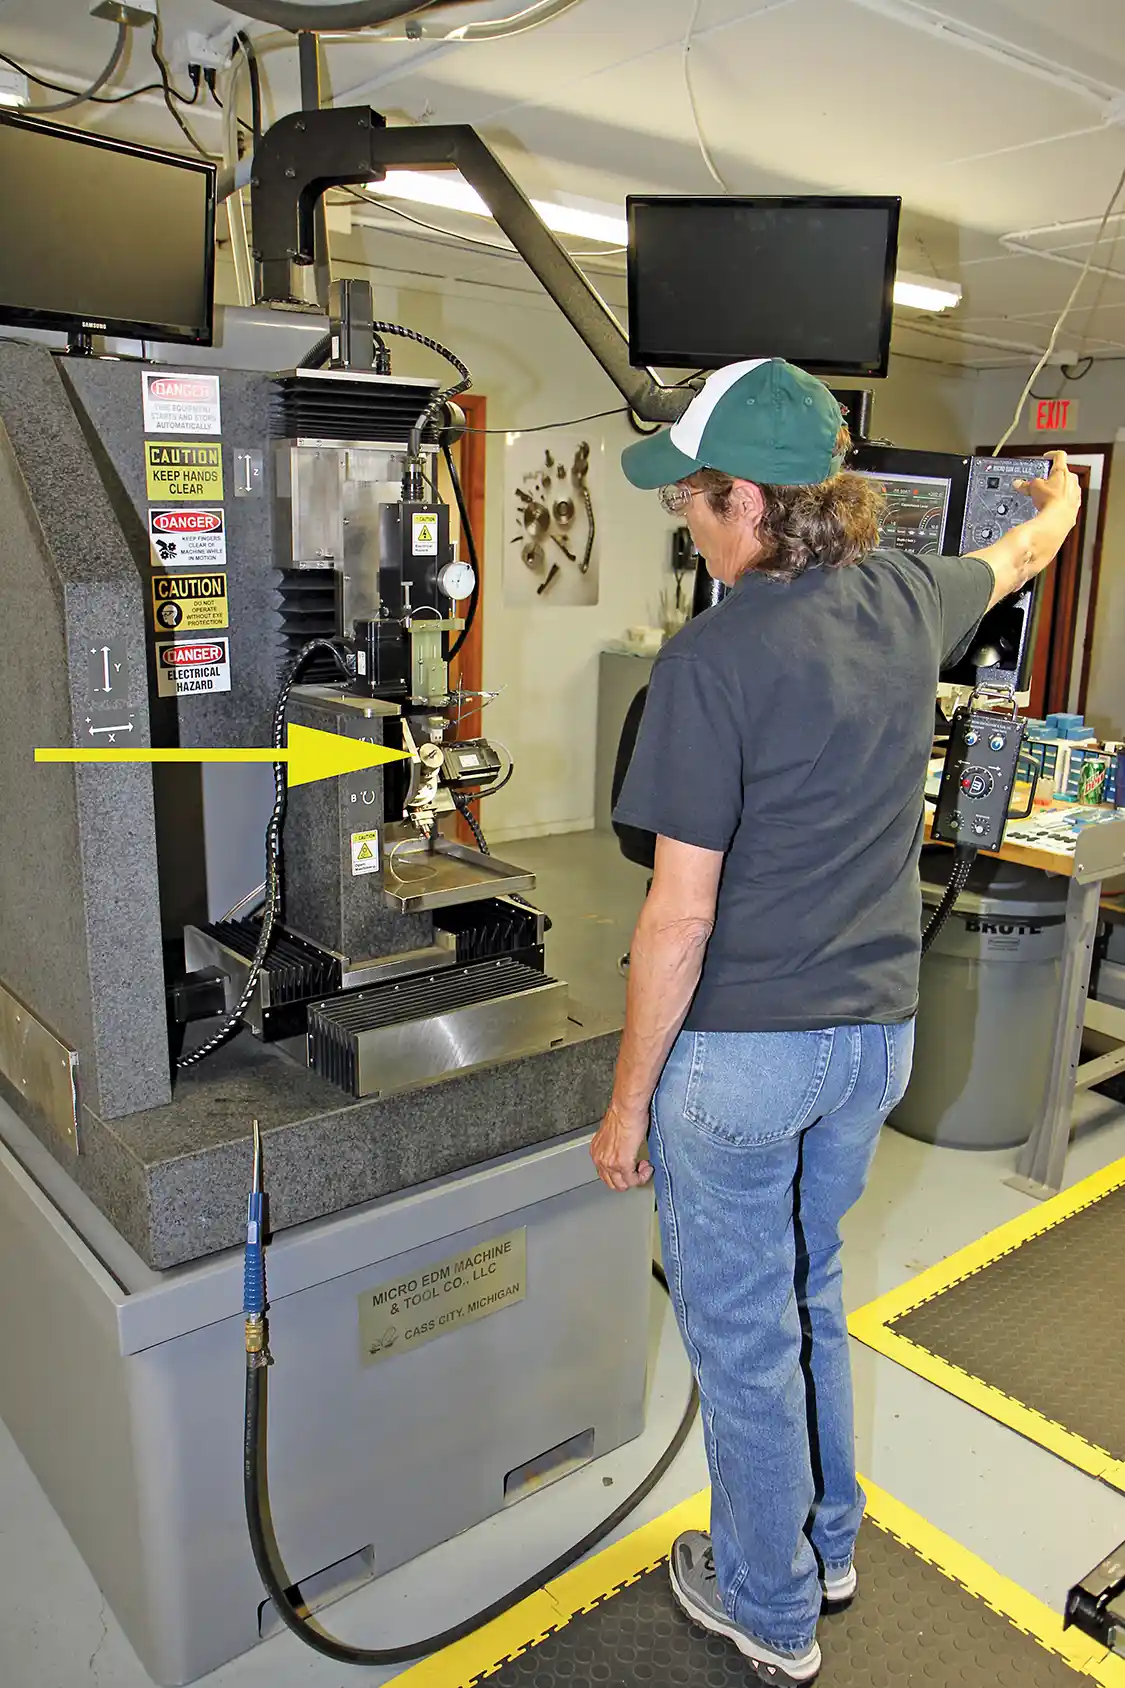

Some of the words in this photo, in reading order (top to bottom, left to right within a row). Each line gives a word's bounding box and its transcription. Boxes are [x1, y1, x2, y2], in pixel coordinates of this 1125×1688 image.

[82, 321, 107, 330] SAMSUNG
[155, 382, 211, 398] DANGER
[151, 412, 177, 420] STARTS
[178, 413, 193, 421] AND
[1036, 400, 1071, 430] EXIT
[156, 421, 212, 430] AUTOMATICALLY
[151, 448, 218, 465] CAUTION
[153, 470, 180, 481] KEEP
[183, 471, 218, 482] HANDS
[253, 468, 260, 476] Z
[169, 483, 204, 495] CLEAR
[159, 516, 215, 530] DANGER
[159, 578, 222, 598] CAUTION
[167, 647, 219, 663] DANGER
[114, 663, 121, 672] Y
[167, 666, 221, 681] ELECTRICAL
[177, 679, 213, 692] HAZARD
[108, 733, 116, 743] X
[351, 793, 357, 803] B
[358, 833, 375, 841] CAUTION
[372, 1280, 418, 1307] MICRO
[421, 1266, 451, 1288] EDM
[454, 1241, 512, 1275] MACHINE
[390, 1303, 400, 1315] &
[403, 1287, 440, 1310] TOOL
[473, 1262, 497, 1281] LLC
[404, 1320, 435, 1340] CASS
[467, 1282, 520, 1314] MICHIGAN
